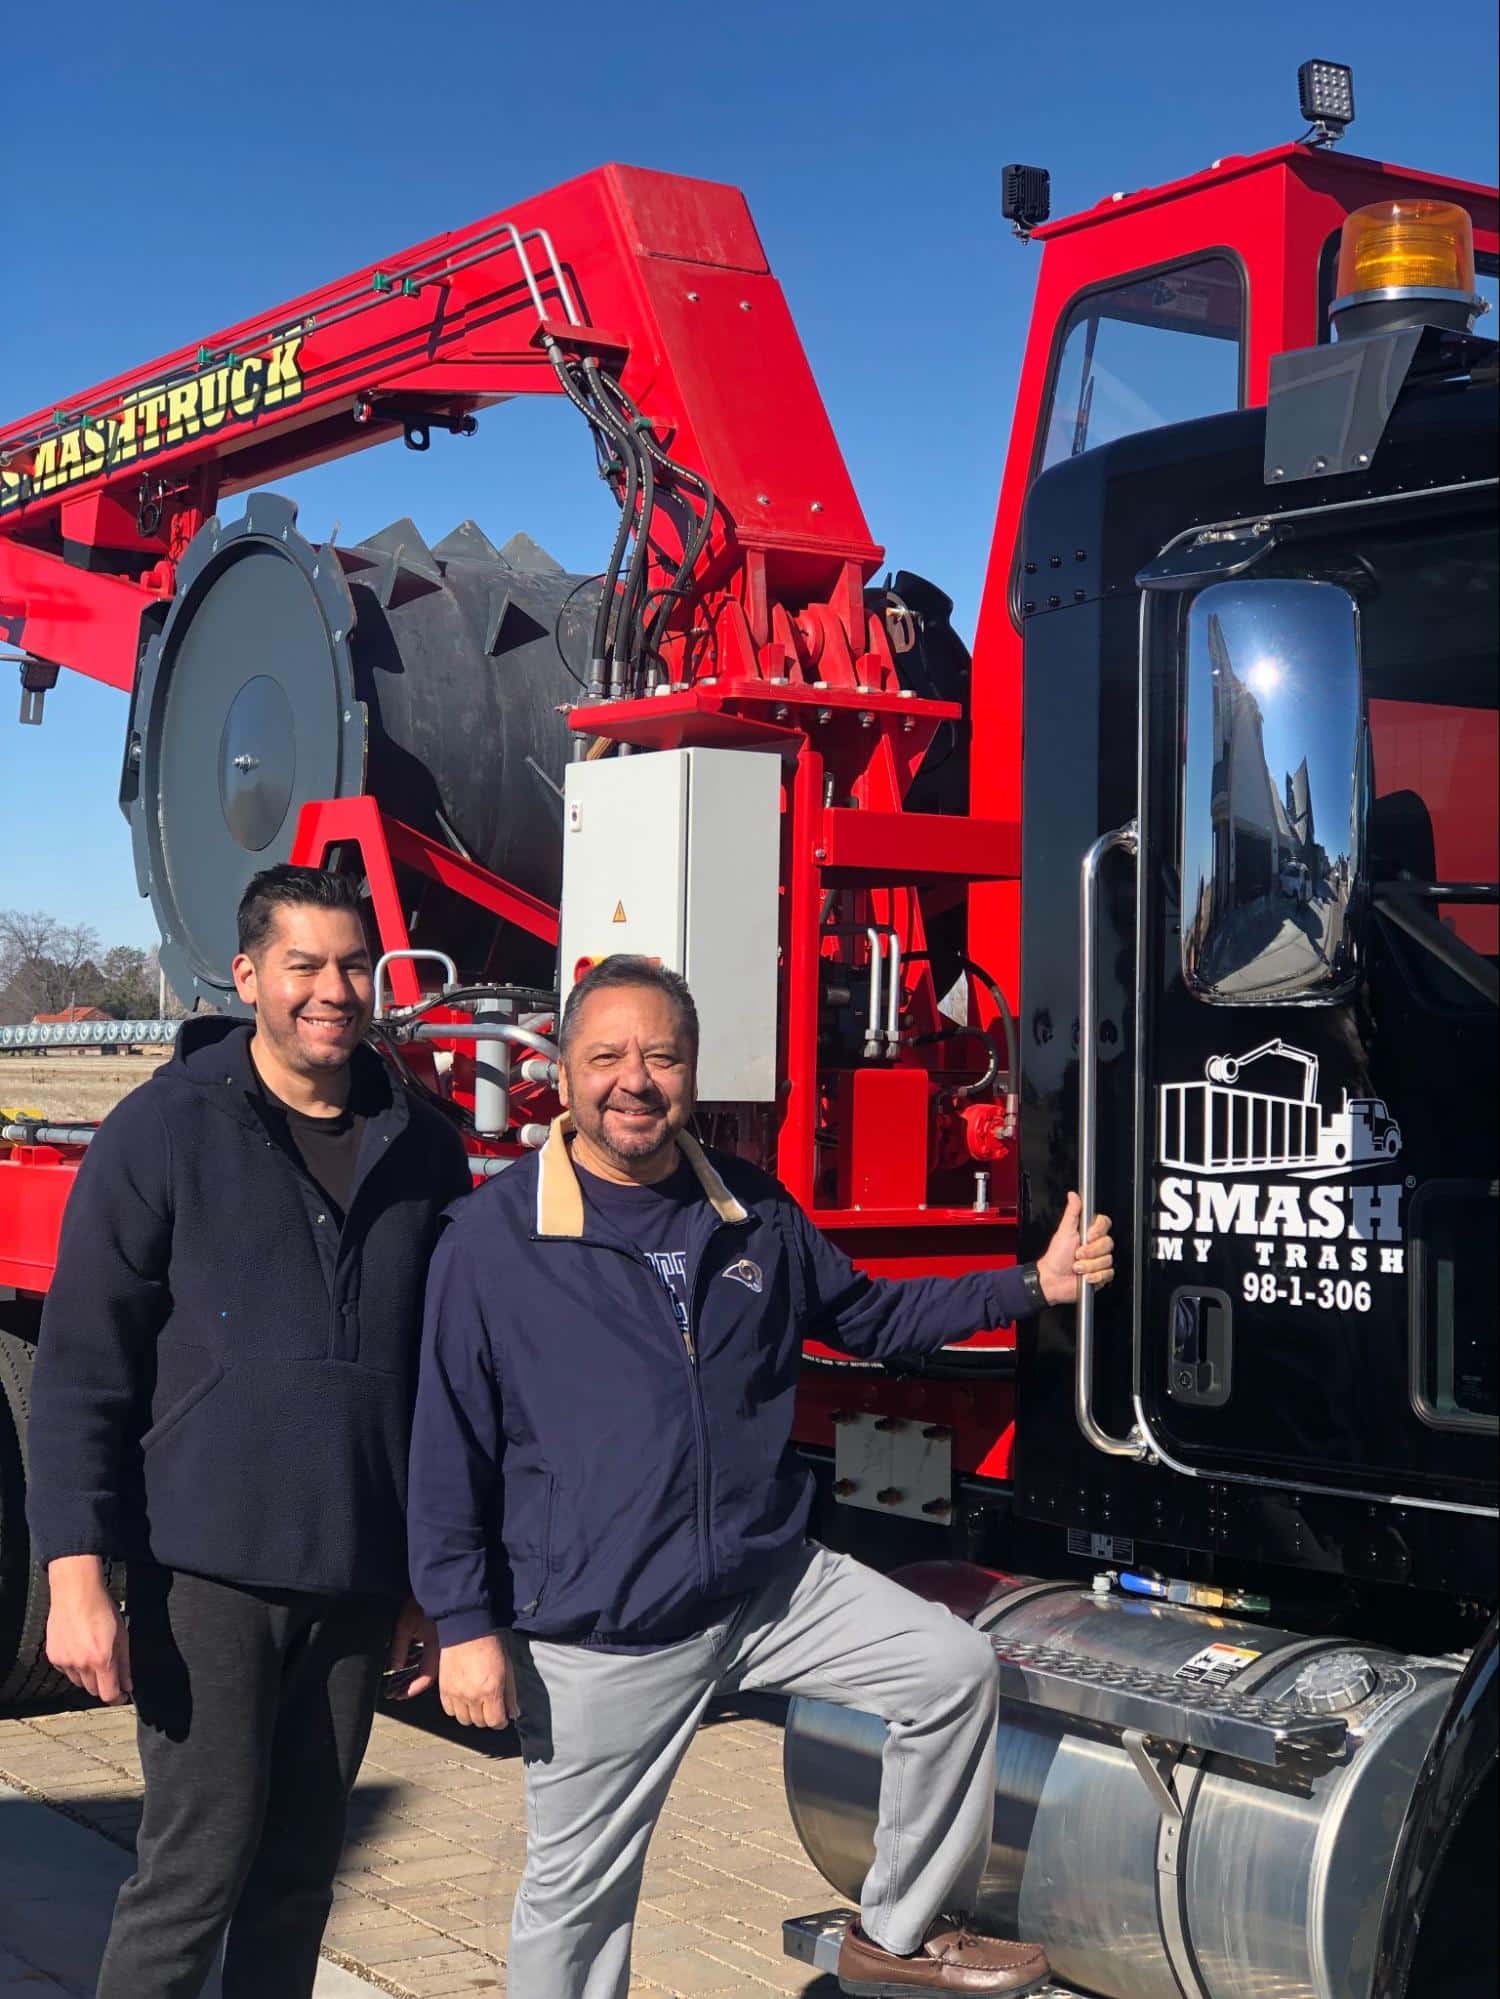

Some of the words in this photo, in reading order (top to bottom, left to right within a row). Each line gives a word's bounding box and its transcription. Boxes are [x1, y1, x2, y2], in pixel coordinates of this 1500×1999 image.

[1157, 1237, 1212, 1263] MY
[1255, 1242, 1404, 1273] TRASH
[1243, 1272, 1372, 1312] 98-1-306
